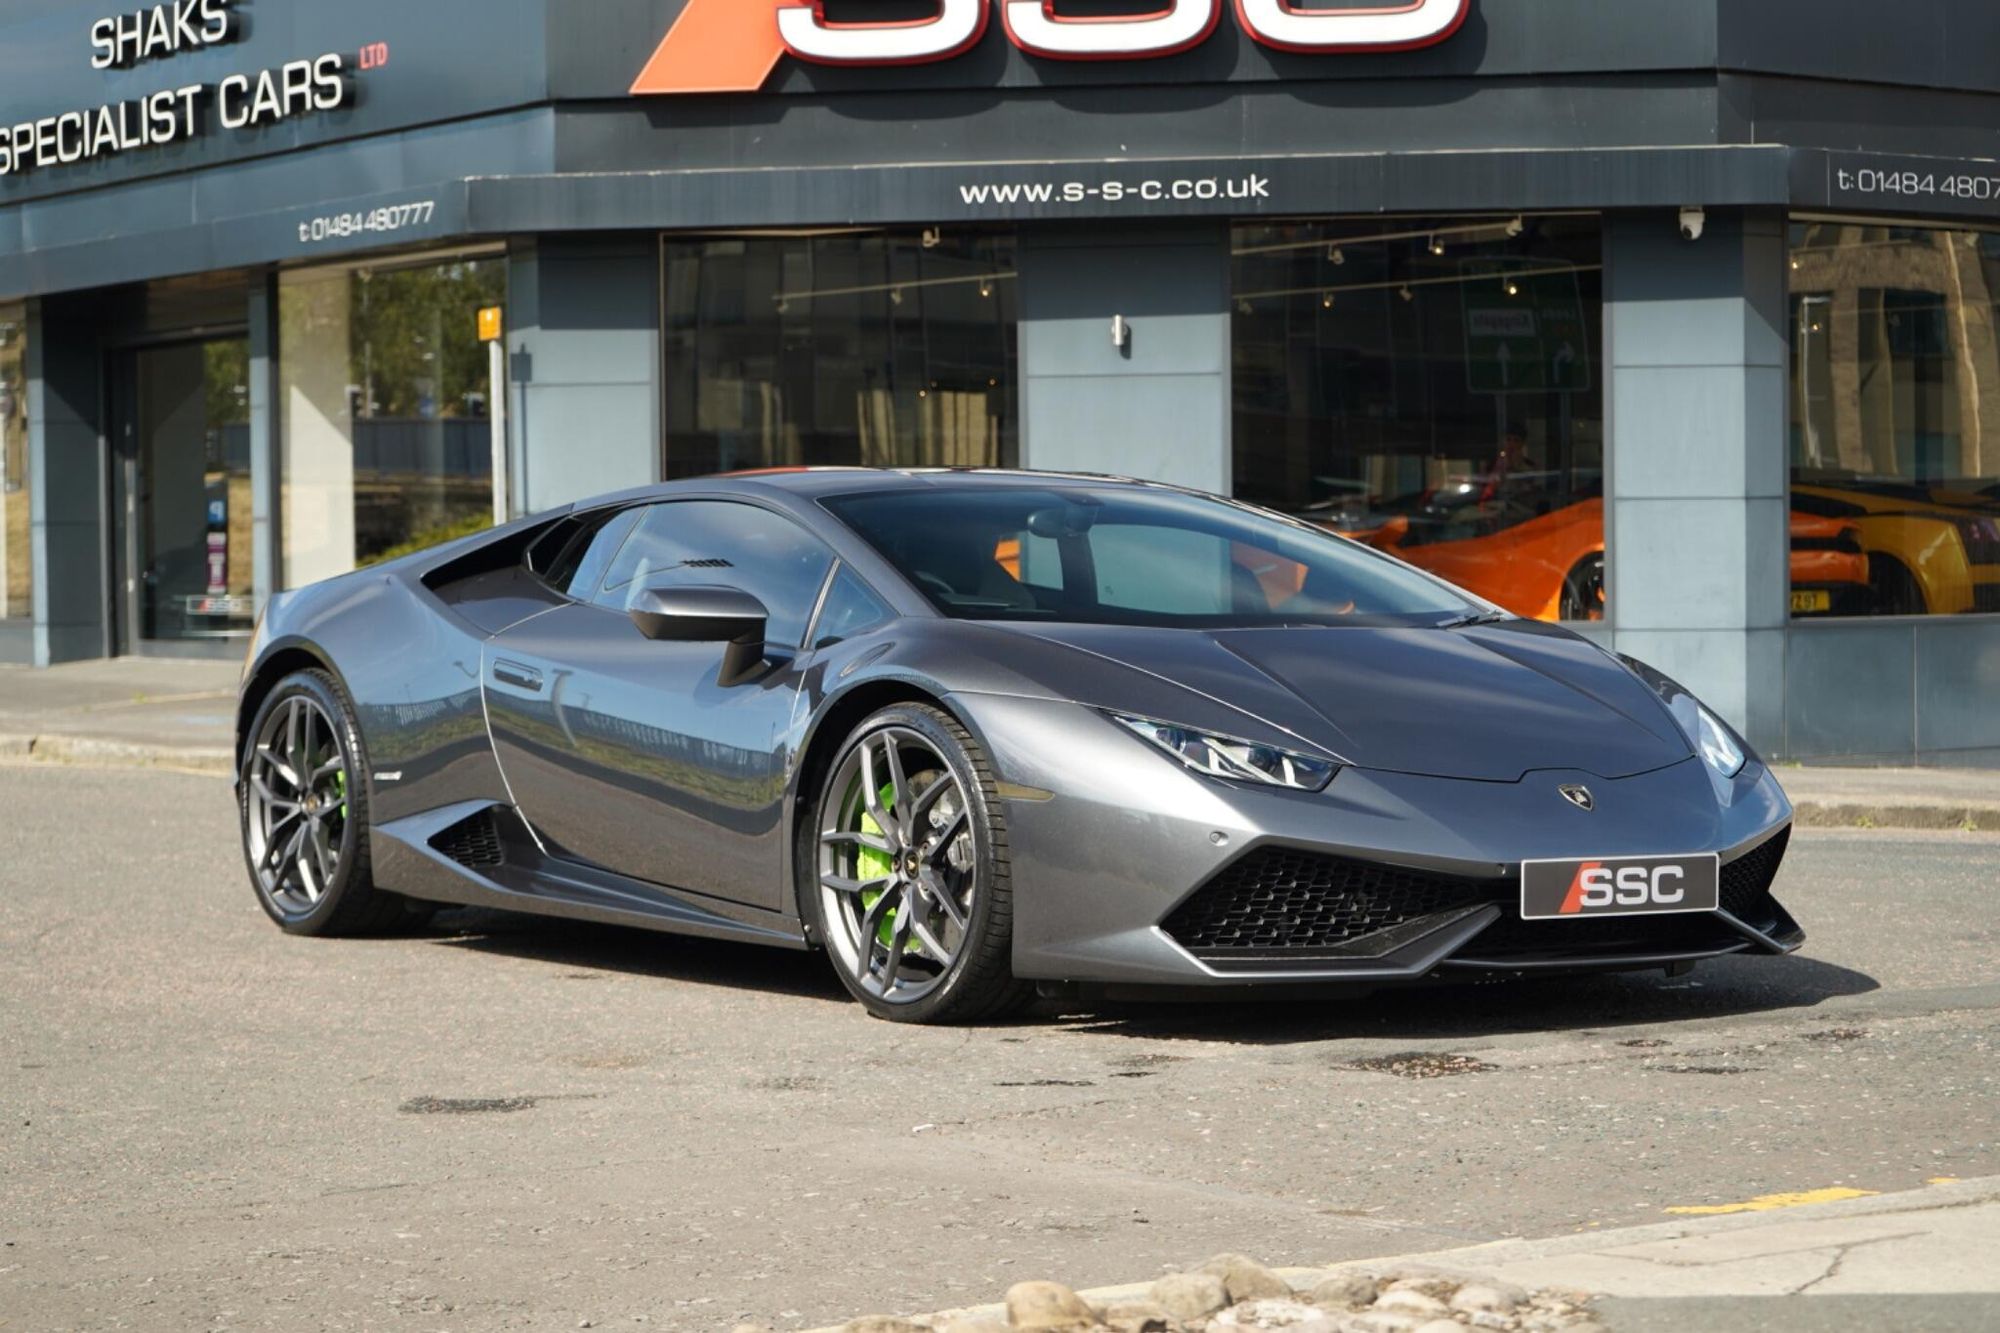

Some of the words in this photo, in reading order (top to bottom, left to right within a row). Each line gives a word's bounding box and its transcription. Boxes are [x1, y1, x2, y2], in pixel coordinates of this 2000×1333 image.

[91, 0, 227, 69] SHAKS
[219, 53, 342, 129] CARS
[359, 41, 388, 70] LTD
[960, 173, 1270, 204] www.s-s-c.co.uk
[1579, 865, 1684, 907] SSC
